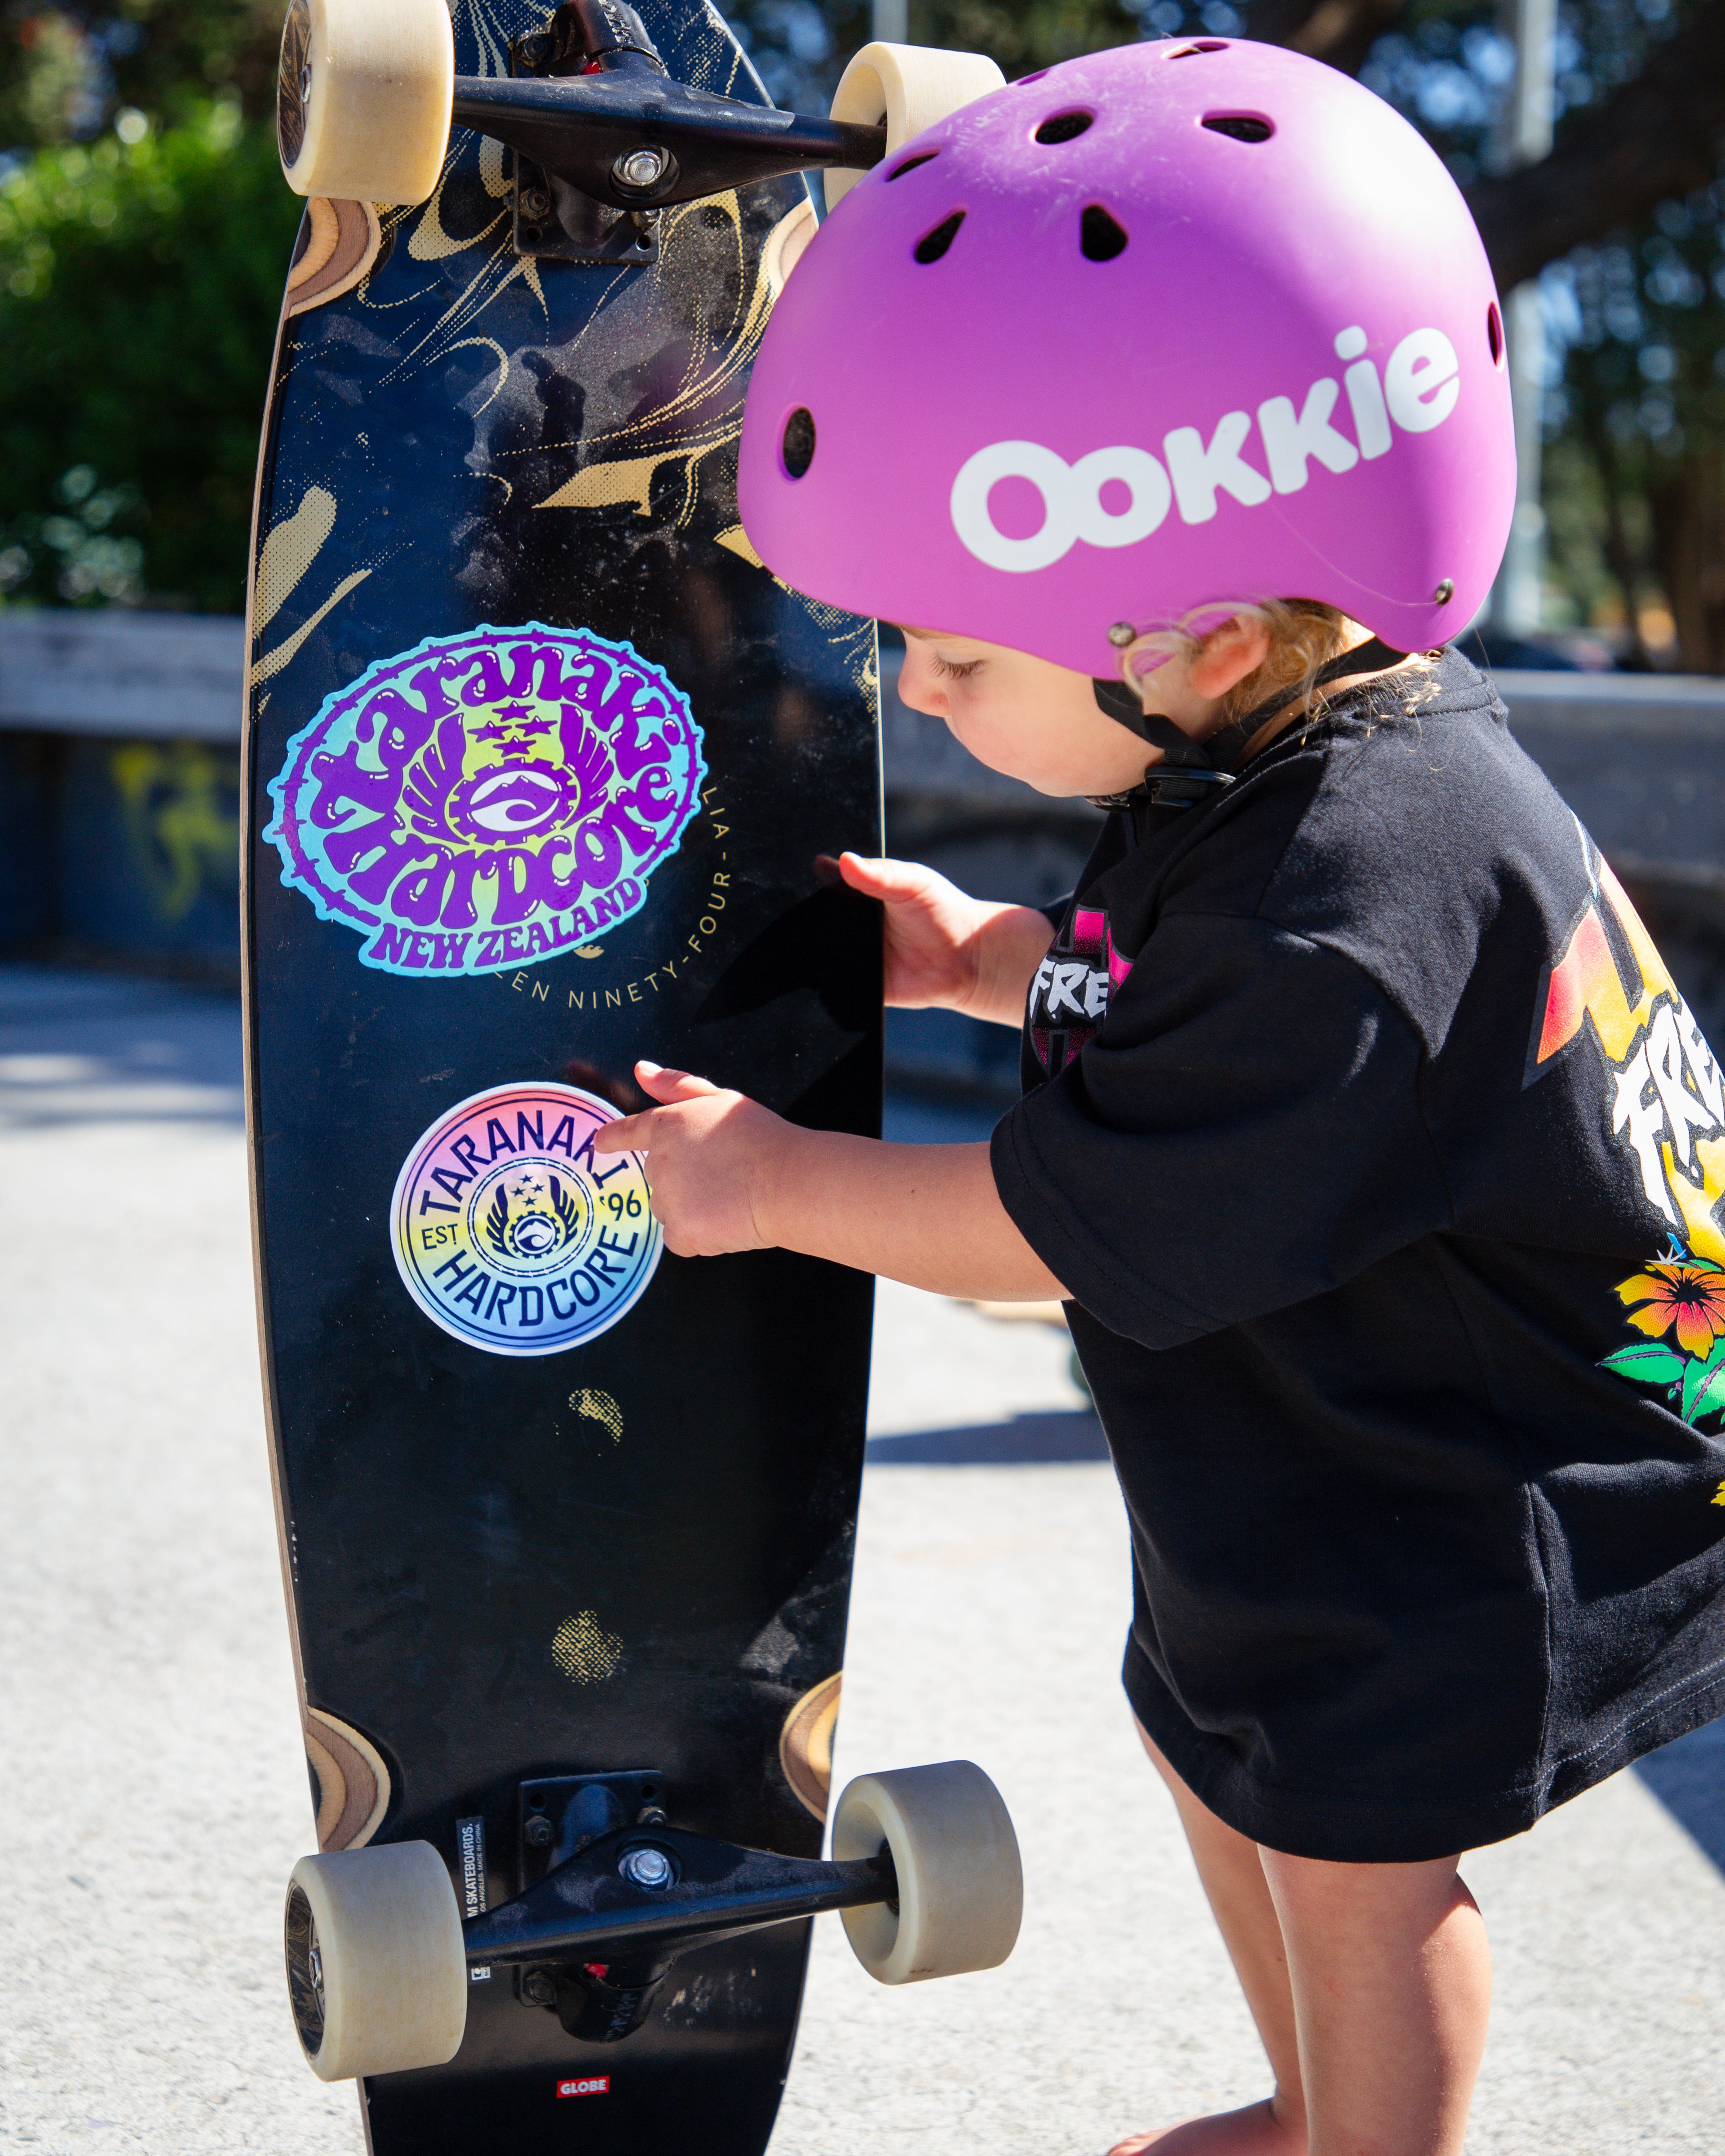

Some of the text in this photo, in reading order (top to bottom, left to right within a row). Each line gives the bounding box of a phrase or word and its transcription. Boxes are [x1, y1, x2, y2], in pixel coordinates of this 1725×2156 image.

[950, 325, 1460, 573] Ookkie
[368, 878, 641, 968] NEW ZEALAND
[1030, 954, 1109, 1019] FRE
[420, 1110, 629, 1216] TARANAKI
[420, 1223, 458, 1250] EST
[433, 1225, 640, 1326] HARDCORE
[560, 2079, 607, 2095] GLOBE
